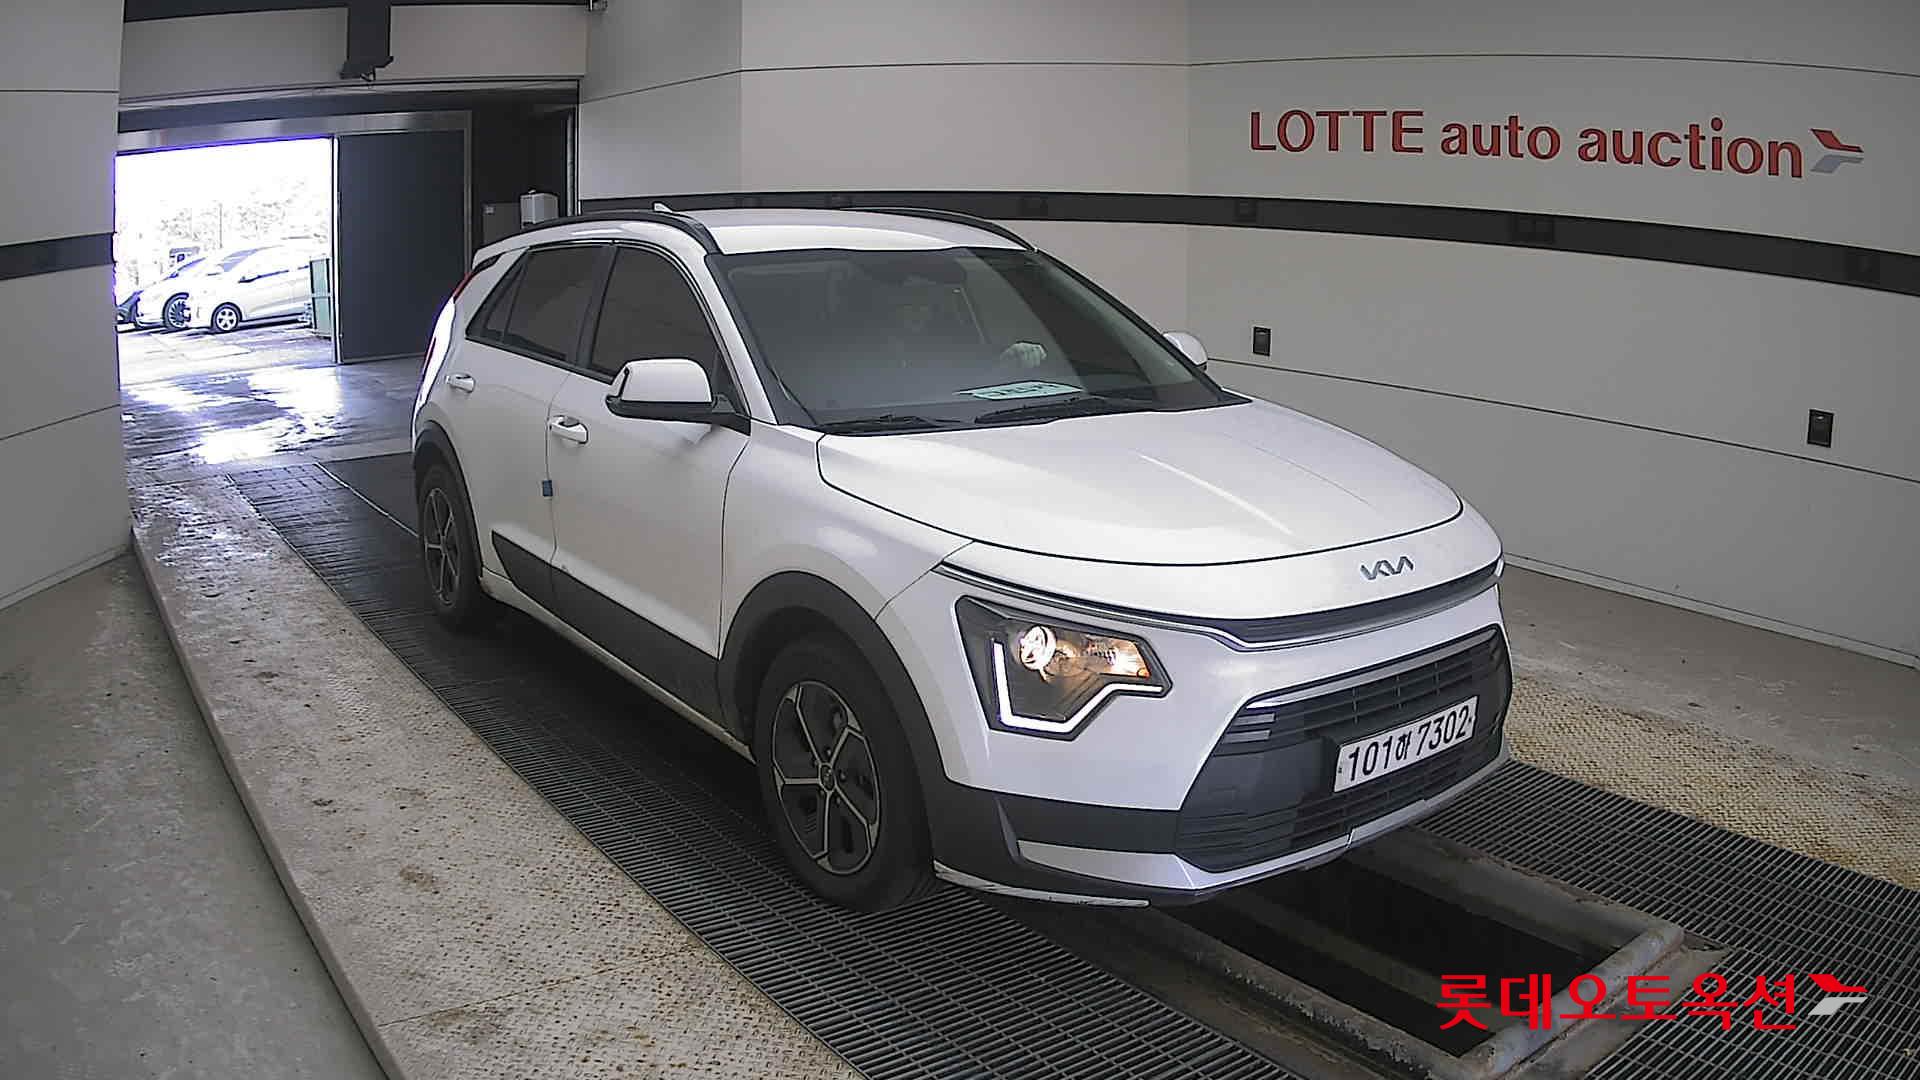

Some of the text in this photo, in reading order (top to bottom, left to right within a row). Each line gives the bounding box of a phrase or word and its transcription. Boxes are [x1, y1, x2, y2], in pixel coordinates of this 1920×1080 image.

[1250, 110, 1803, 178] LOTTE auto auction
